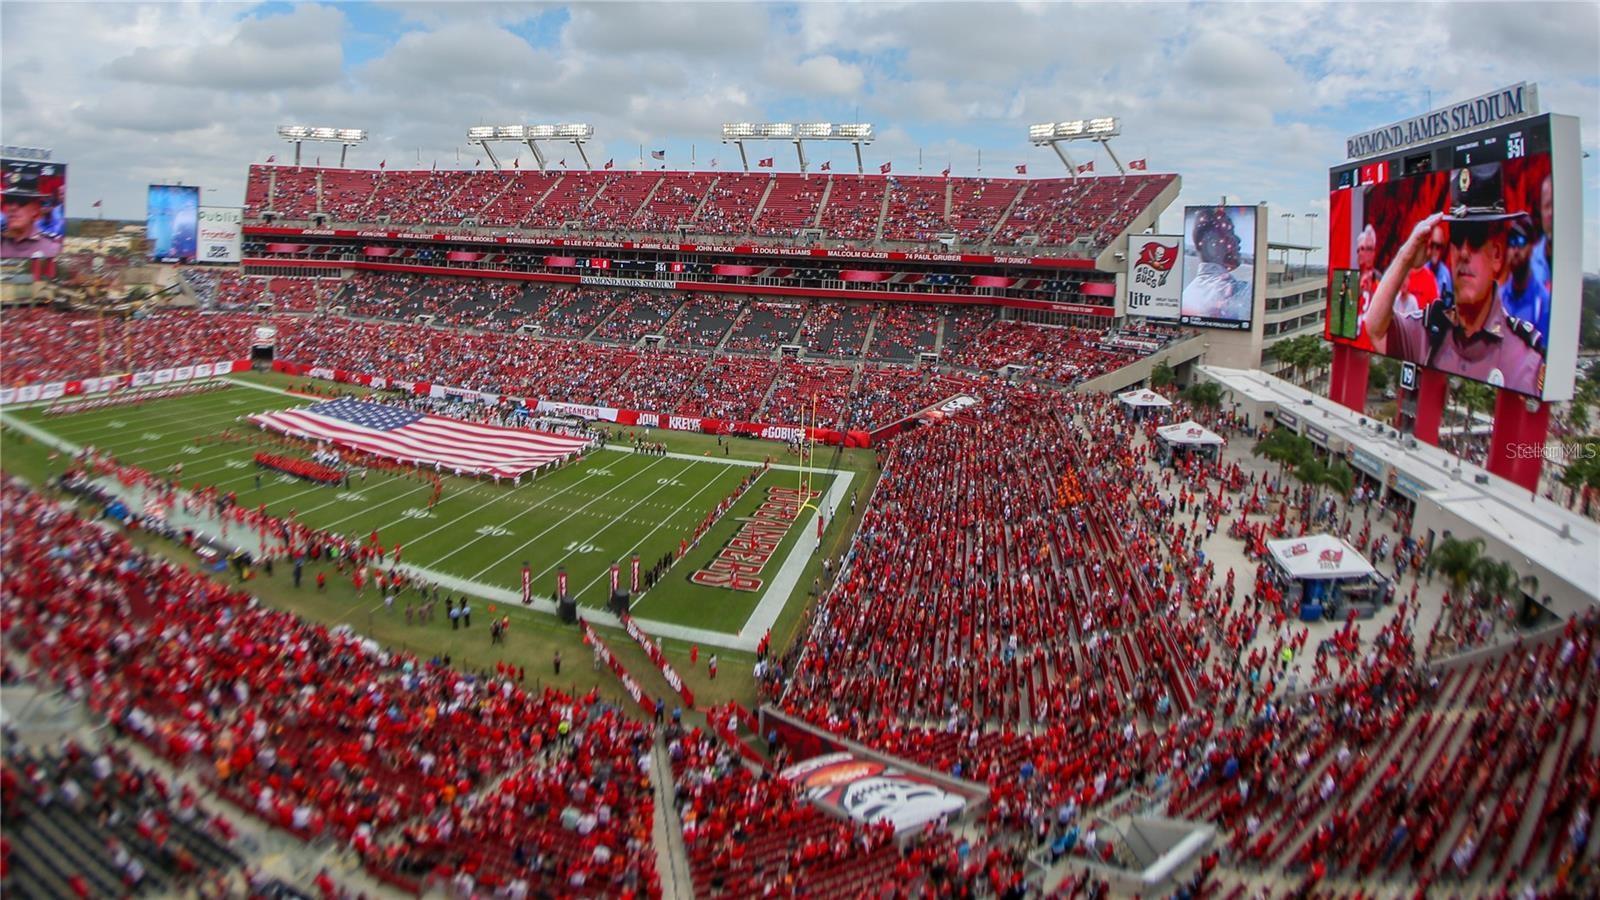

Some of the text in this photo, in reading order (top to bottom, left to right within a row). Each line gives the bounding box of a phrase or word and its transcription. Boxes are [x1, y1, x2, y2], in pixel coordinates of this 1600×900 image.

[1346, 86, 1525, 159] RAYMOND JAMES STADIUM
[198, 210, 241, 225] Publix
[780, 248, 811, 256] WILLIAMS
[828, 250, 889, 259] MALCOLM GLAZER
[932, 254, 962, 262] GRUBER
[582, 276, 618, 285] RAYMOND
[643, 281, 675, 289] STADIUM
[1136, 273, 1157, 289] BUCS
[1128, 291, 1151, 309] Lite
[1403, 367, 1413, 384] 19
[636, 412, 660, 428] JOIN
